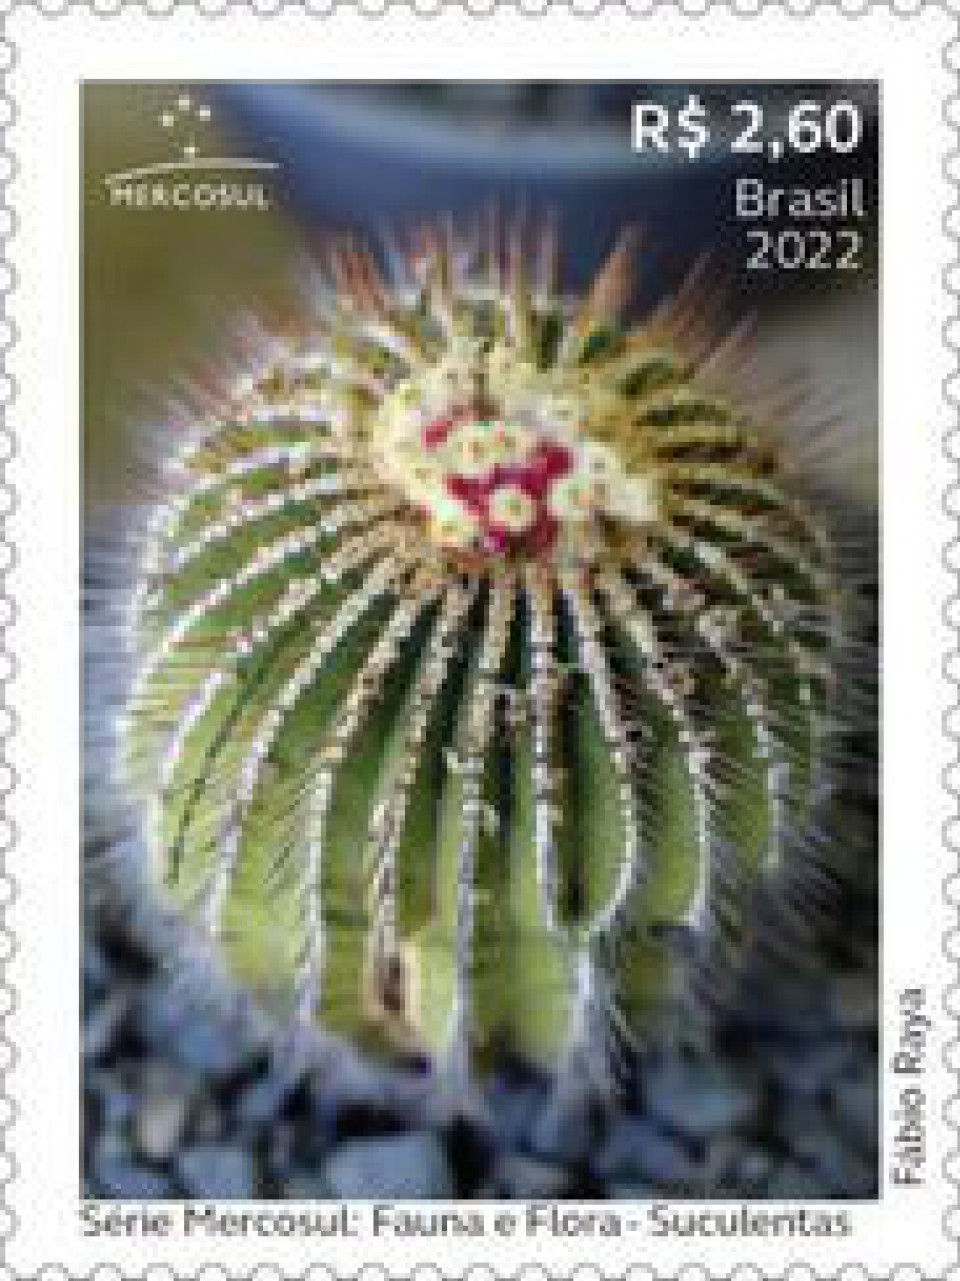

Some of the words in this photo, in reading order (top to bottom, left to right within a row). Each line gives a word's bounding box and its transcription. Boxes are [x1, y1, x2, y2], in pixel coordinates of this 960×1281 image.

[630, 96, 708, 158] R$
[729, 101, 863, 160] 2,60
[108, 183, 270, 208] MERCOSUL
[735, 177, 864, 218] Brasil
[746, 230, 863, 270] 2022
[893, 987, 934, 1076] Raya
[893, 1088, 926, 1186] Fábio
[79, 1208, 172, 1238] Série
[183, 1208, 358, 1238] Mercosul:
[372, 1208, 484, 1238] Fauna
[494, 1216, 516, 1238] e
[526, 1208, 620, 1238] Flora
[648, 1208, 852, 1238] Suculentas
